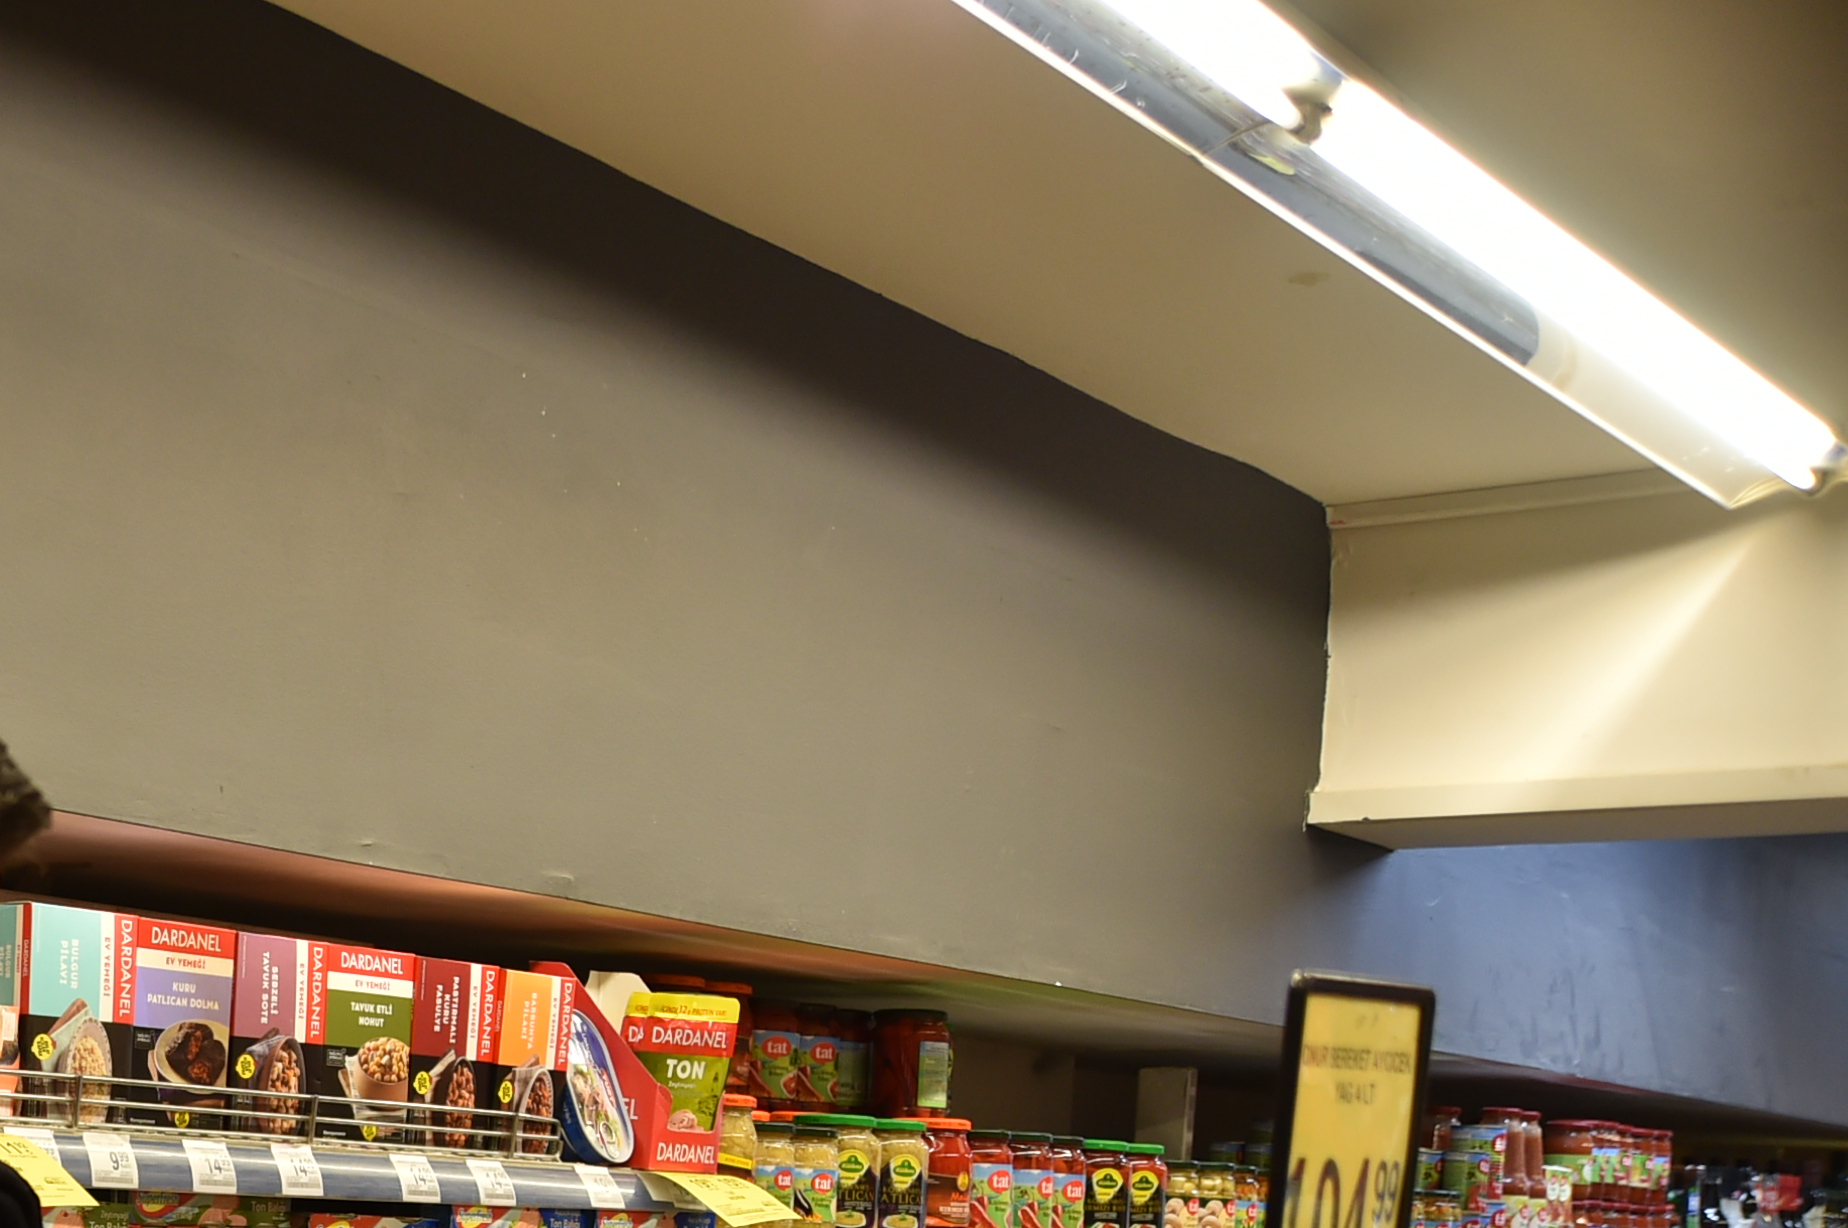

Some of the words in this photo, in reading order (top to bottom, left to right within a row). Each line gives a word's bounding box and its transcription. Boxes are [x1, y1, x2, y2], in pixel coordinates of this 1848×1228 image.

[104, 936, 112, 952] EV
[152, 926, 221, 952] DARDANEL
[59, 939, 68, 985] PİLAVI
[70, 938, 80, 990] BULGUR
[119, 919, 134, 1017] DARDANEL
[165, 956, 176, 965] EV
[341, 951, 404, 975] DARDANEL
[262, 951, 270, 995] TAVUK
[172, 981, 197, 994] KURU
[271, 966, 279, 1016] SEBZELİ
[310, 946, 323, 1038] DARDANEL
[354, 979, 363, 988] EV
[147, 993, 187, 1007] PATLICAN
[190, 997, 220, 1011] DOLMA
[260, 998, 269, 1025] SOTE
[351, 1001, 375, 1014] TAVUK
[376, 1002, 393, 1016] ETLİ
[358, 1015, 385, 1028] NOHUT
[480, 970, 496, 1057] DARDANEL
[652, 1026, 728, 1049] DARDANEL
[767, 1040, 788, 1054] tat
[815, 1046, 833, 1060] tat
[666, 1058, 706, 1080] TON
[109, 1151, 120, 1170] 9
[657, 1142, 715, 1164] DARDANEL
[777, 1173, 793, 1187] tat
[815, 1176, 834, 1190] tat
[992, 1173, 1010, 1188] tat
[1066, 1184, 1083, 1198] tat
